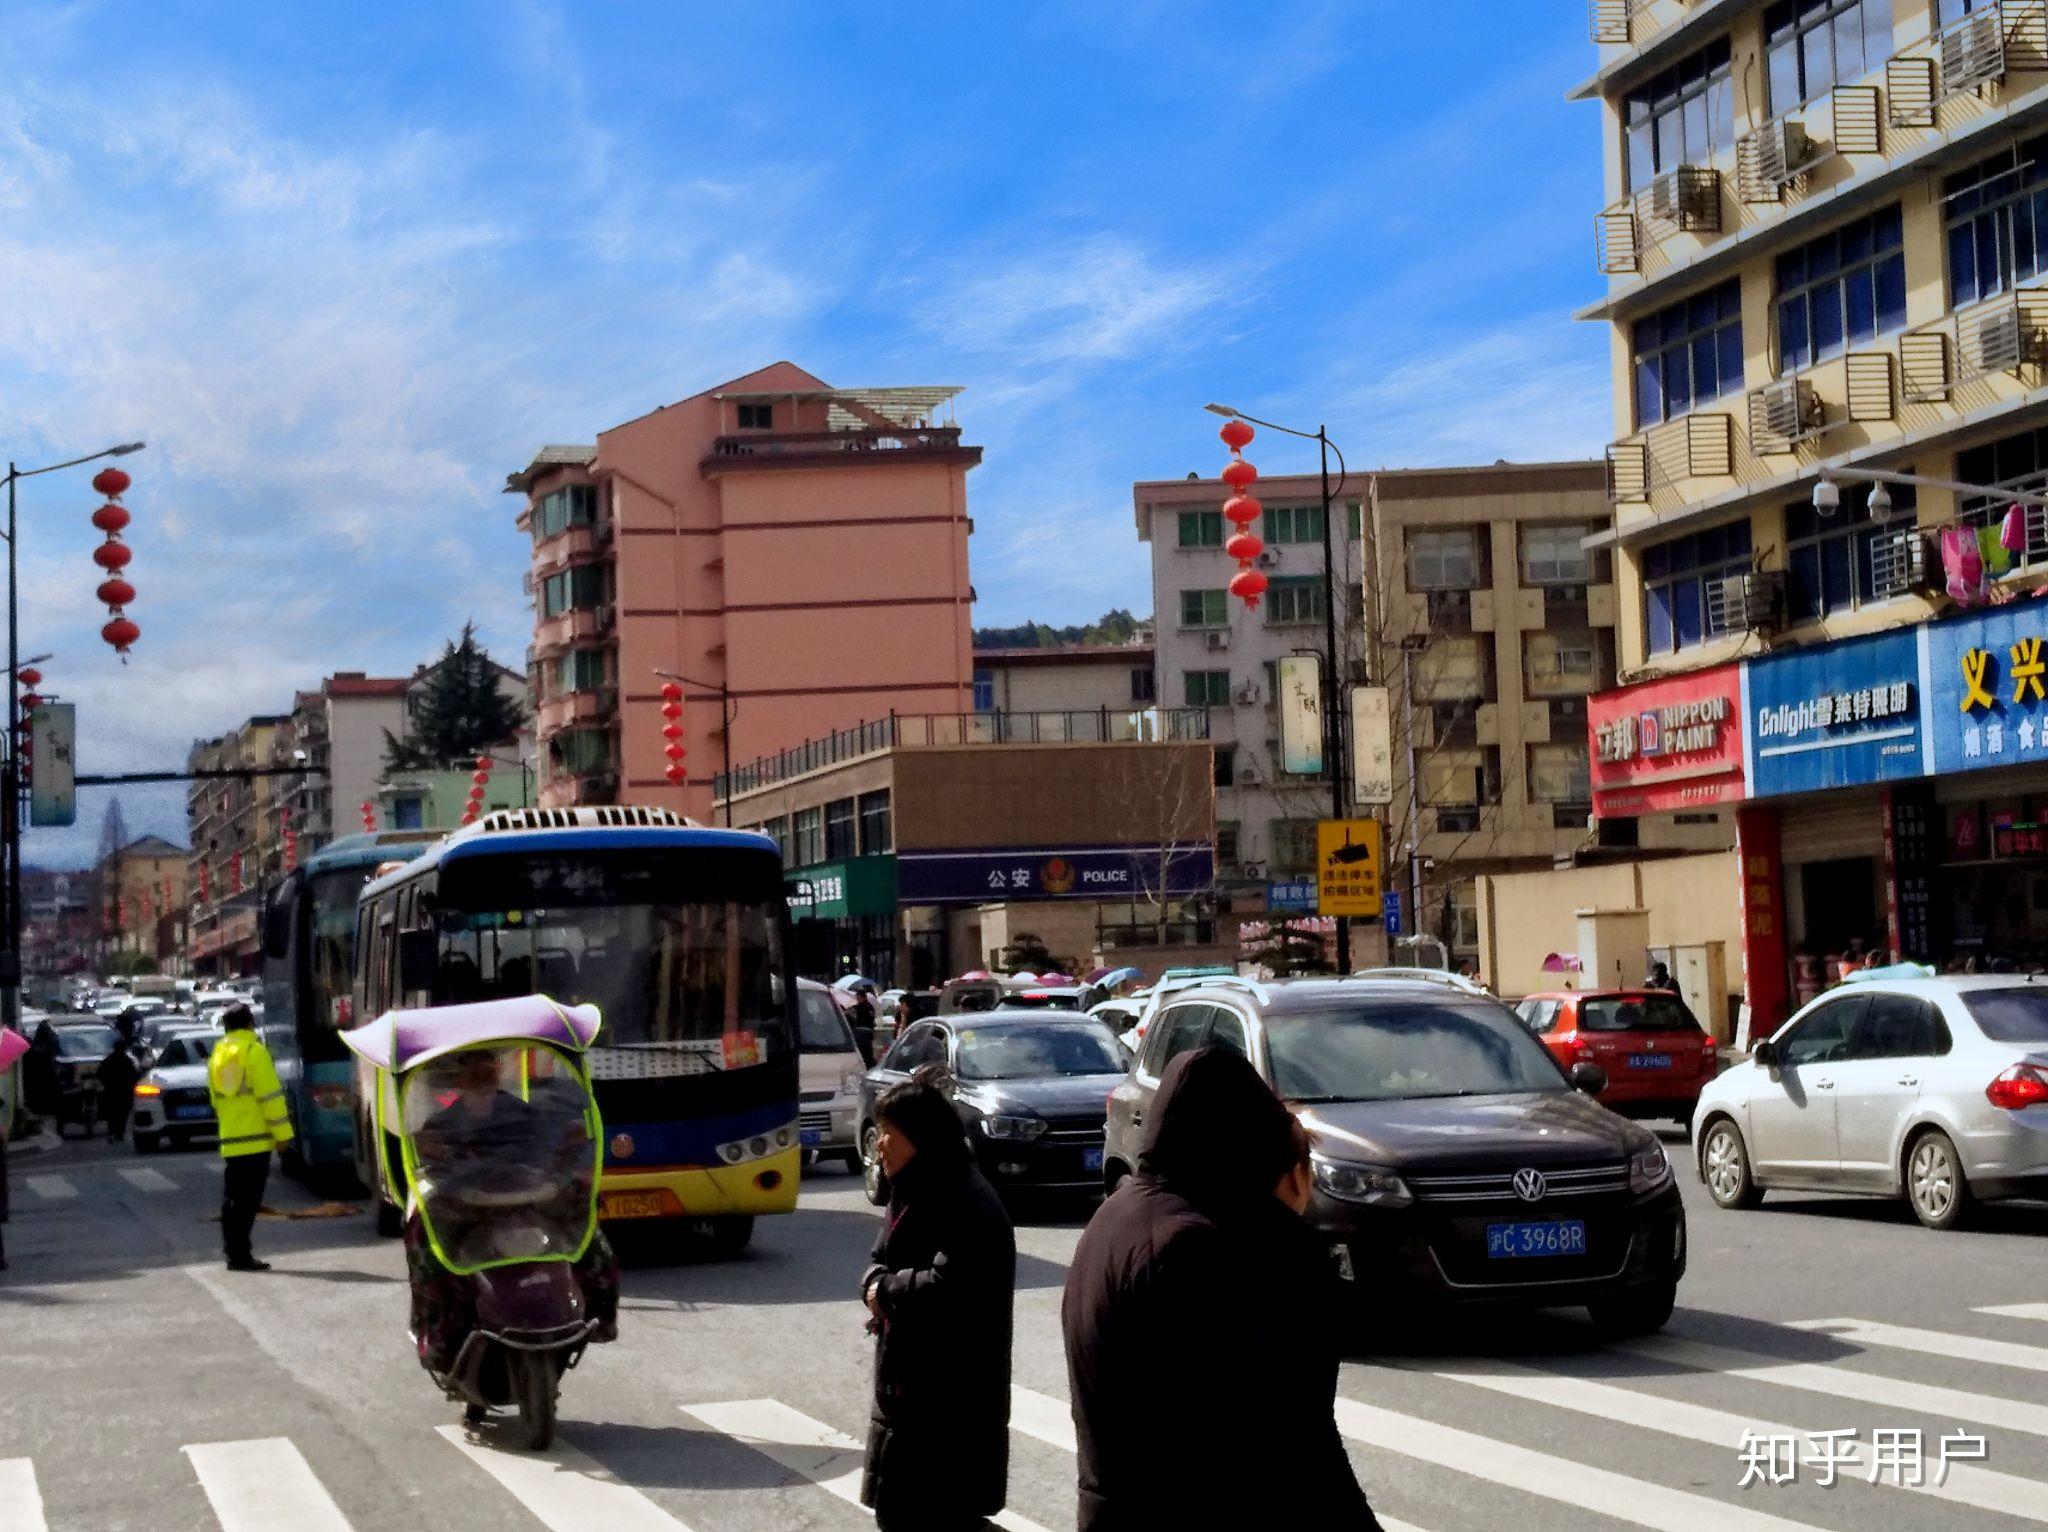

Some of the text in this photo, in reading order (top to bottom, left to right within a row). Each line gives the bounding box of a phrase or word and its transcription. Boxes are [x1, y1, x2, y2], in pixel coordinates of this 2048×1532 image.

[1959, 636, 2046, 713] 义兴
[1663, 697, 1726, 729] NIPPON
[1816, 681, 1909, 726] 雪莱特照明
[1595, 716, 1636, 761] 立邦
[1664, 724, 1715, 754] PAINT
[987, 868, 1128, 888] 公安 POLICE
